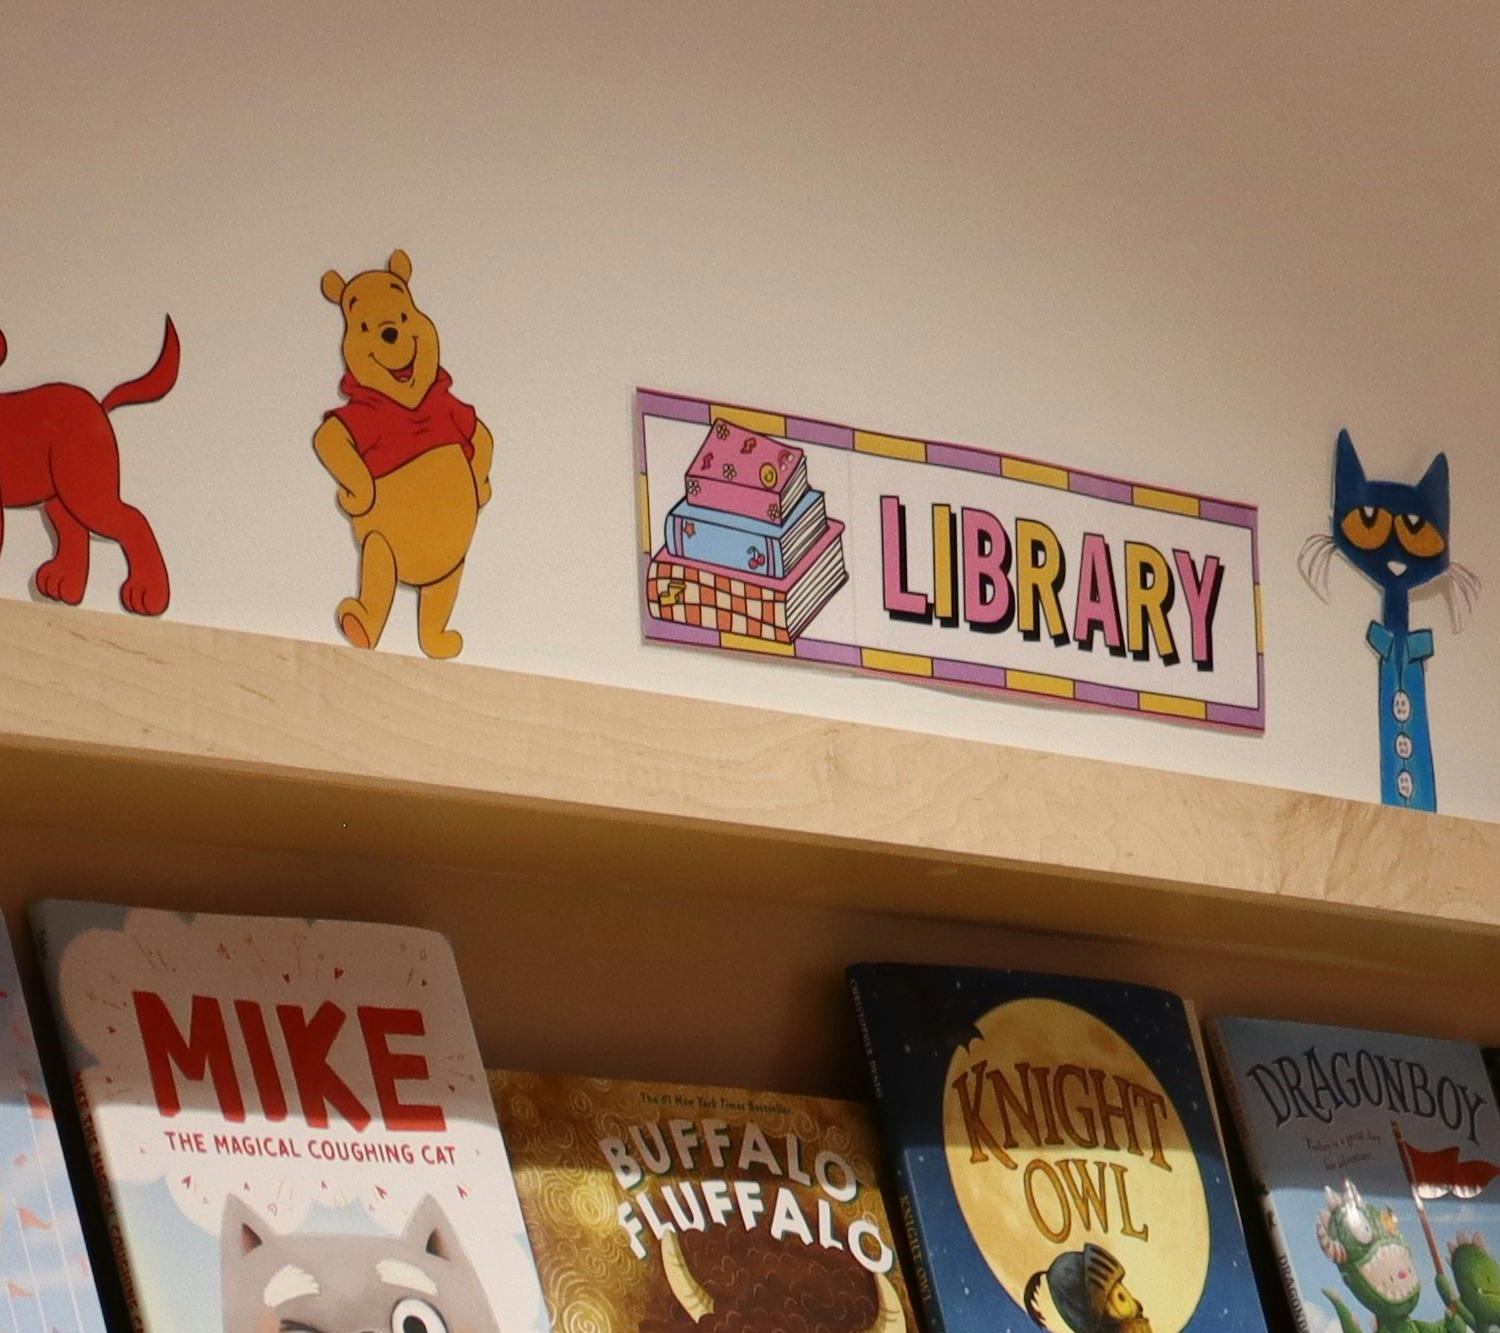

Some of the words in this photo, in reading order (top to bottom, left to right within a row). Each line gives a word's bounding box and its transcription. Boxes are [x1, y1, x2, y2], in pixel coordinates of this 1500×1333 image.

[880, 495, 1224, 671] LIBRARY
[131, 990, 448, 1134] MIKE
[1246, 1046, 1488, 1147] DRAGONBOY
[163, 1130, 208, 1155] THE
[213, 1134, 303, 1159] MAGICAL
[307, 1139, 415, 1165] COUGHING
[420, 1144, 457, 1167] CAT
[600, 1116, 862, 1205] BUFFALO
[952, 1059, 1174, 1172] KNIGHT
[616, 1179, 896, 1275] FLUFFALO
[1023, 1157, 1150, 1243] OWL
